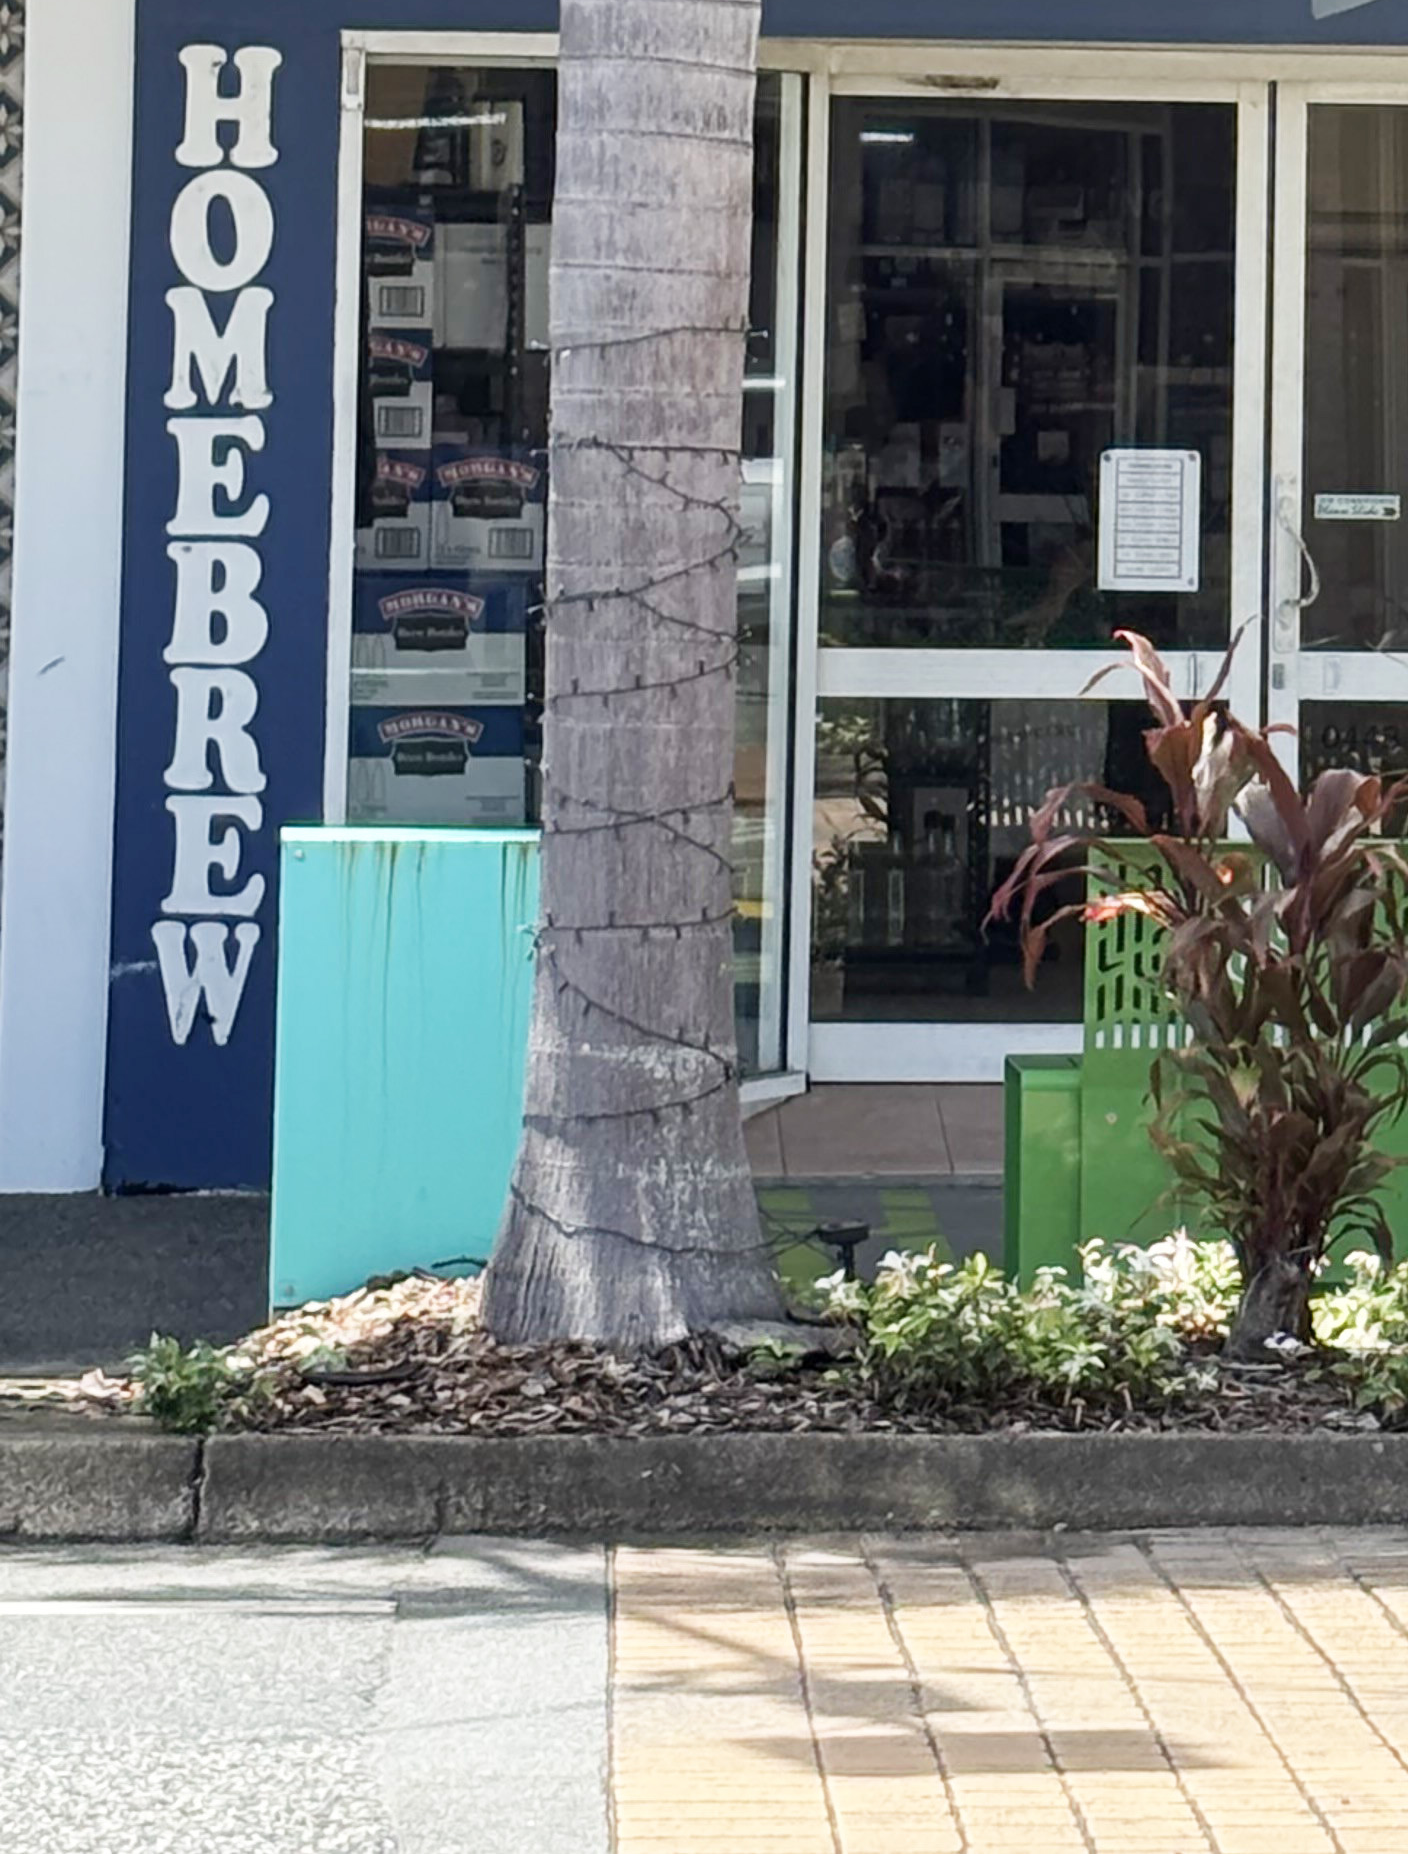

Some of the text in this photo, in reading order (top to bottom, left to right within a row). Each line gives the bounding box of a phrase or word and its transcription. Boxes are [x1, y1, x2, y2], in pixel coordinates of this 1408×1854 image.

[150, 43, 284, 1046] HOMEBREW
[384, 591, 479, 613] MORGAN'S
[383, 714, 478, 737] MORGAN'S
